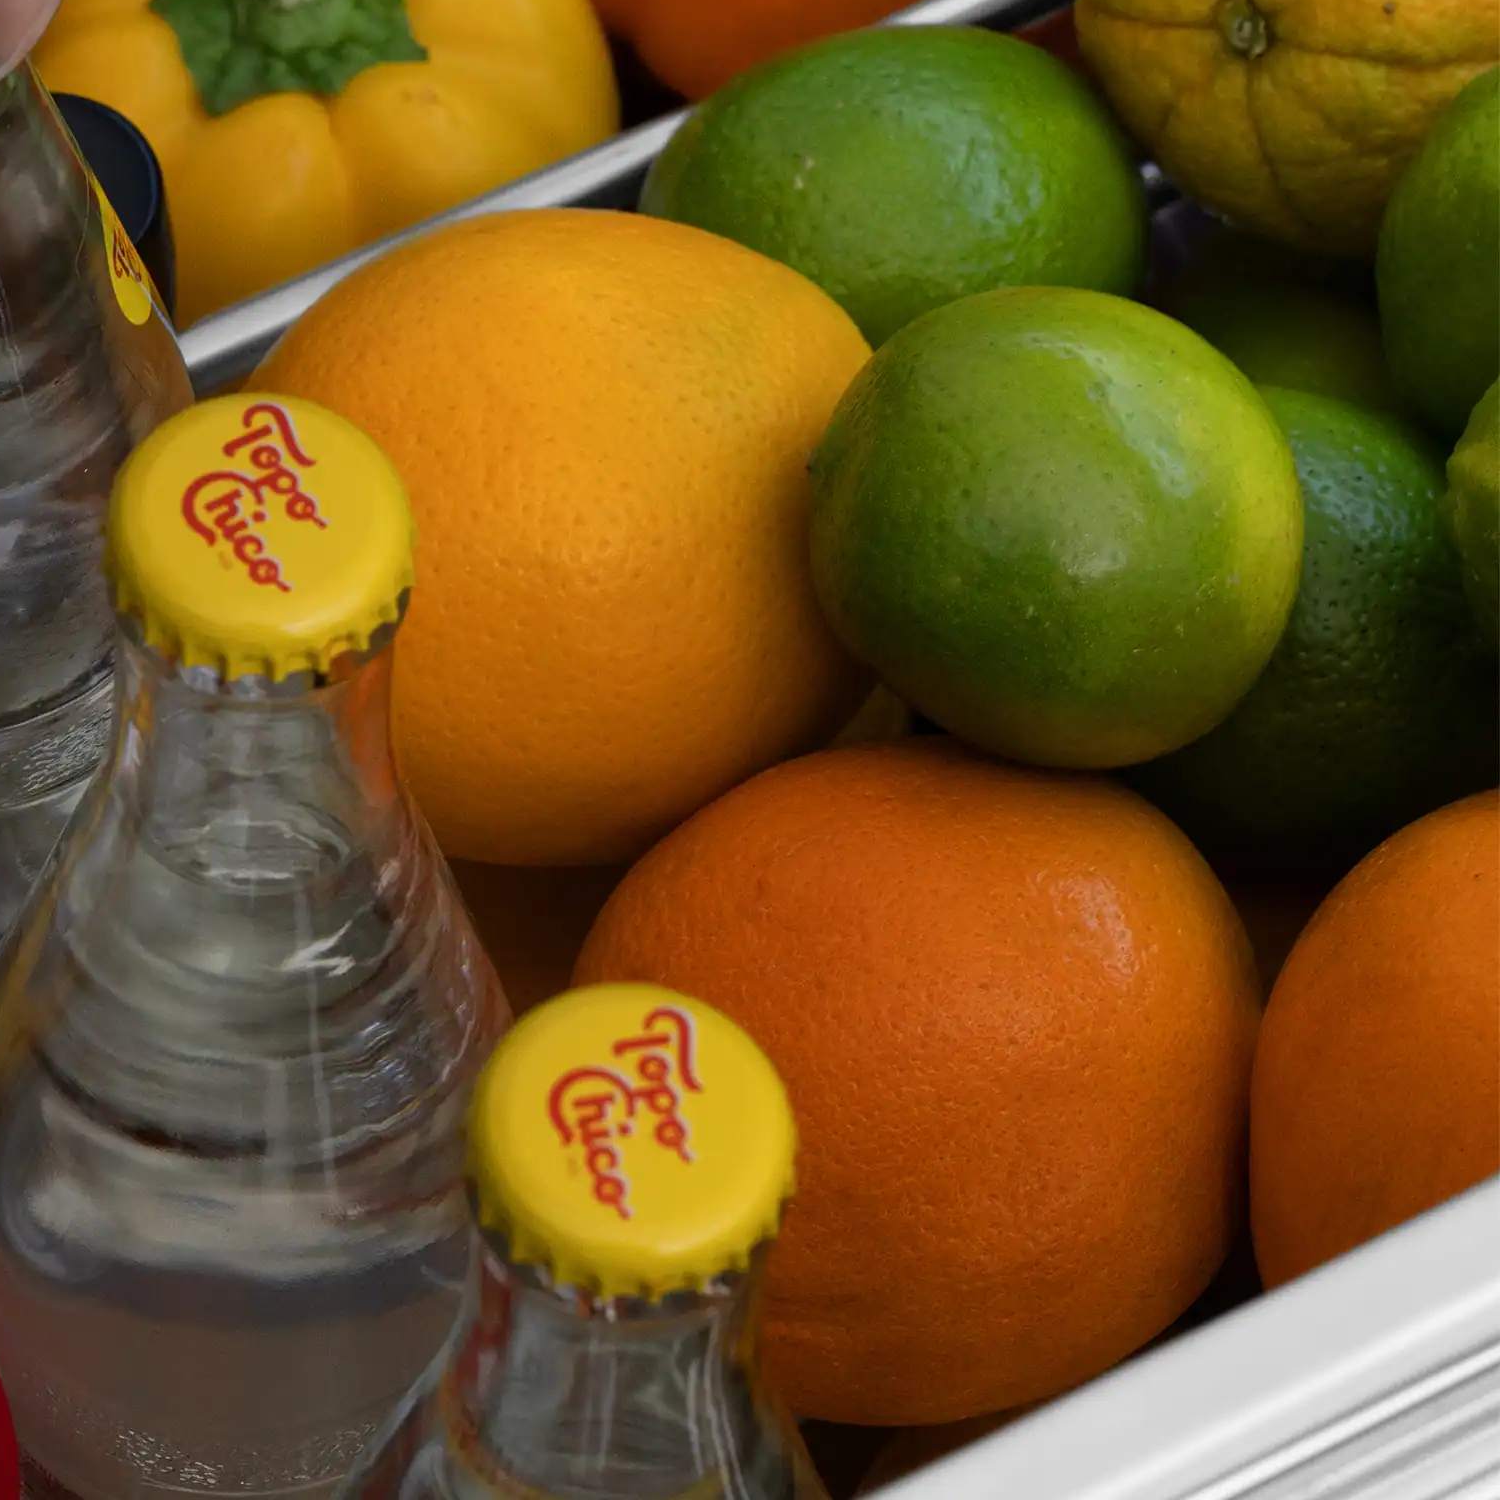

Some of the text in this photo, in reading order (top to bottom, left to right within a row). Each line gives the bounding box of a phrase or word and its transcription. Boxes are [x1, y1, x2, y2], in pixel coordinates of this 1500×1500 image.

[180, 470, 294, 593] Chico
[221, 402, 332, 530] Topo
[546, 1066, 635, 1220] Chico
[611, 1005, 704, 1164] Topo
